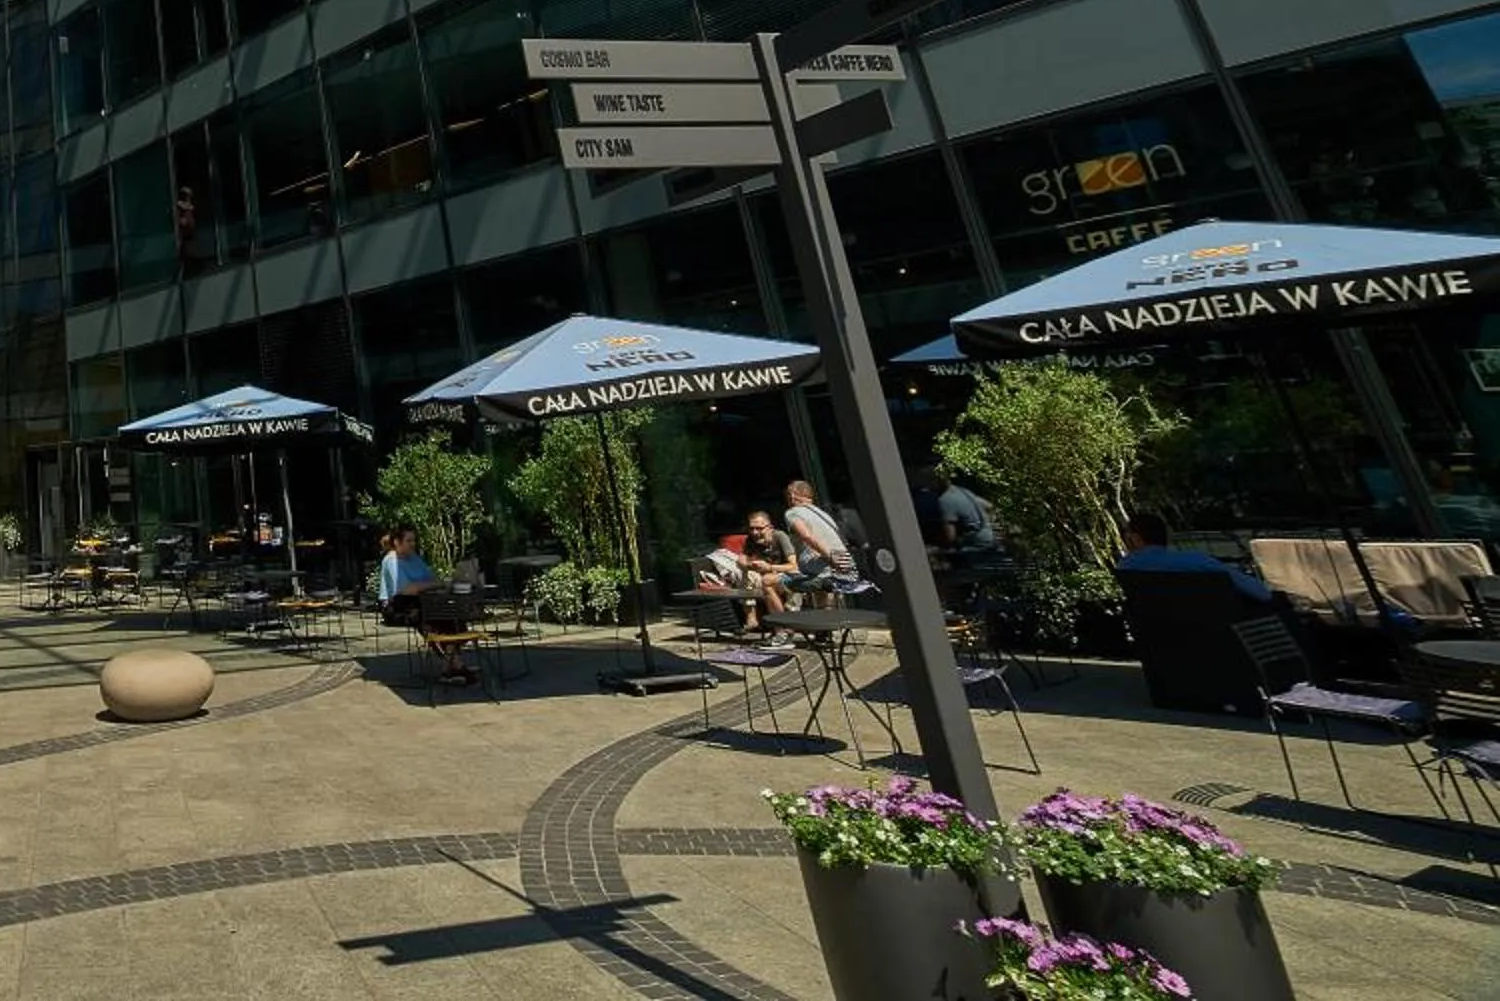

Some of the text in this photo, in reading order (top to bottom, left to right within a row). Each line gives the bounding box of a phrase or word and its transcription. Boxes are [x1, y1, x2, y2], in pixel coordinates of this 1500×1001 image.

[540, 50, 611, 68] COSMO BAR
[828, 54, 865, 72] CAFFE
[864, 54, 894, 72] NERO
[593, 94, 665, 112] WINE TASTE
[575, 138, 634, 158] CITY SAM
[1021, 144, 1186, 216] green
[1019, 270, 1473, 344] CAŁA NADZIEJA W KAWIE
[527, 365, 792, 416] CAŁA NADZIEJA W KAWIE
[146, 418, 309, 445] CAŁA NADZIEJA W KAWIE
